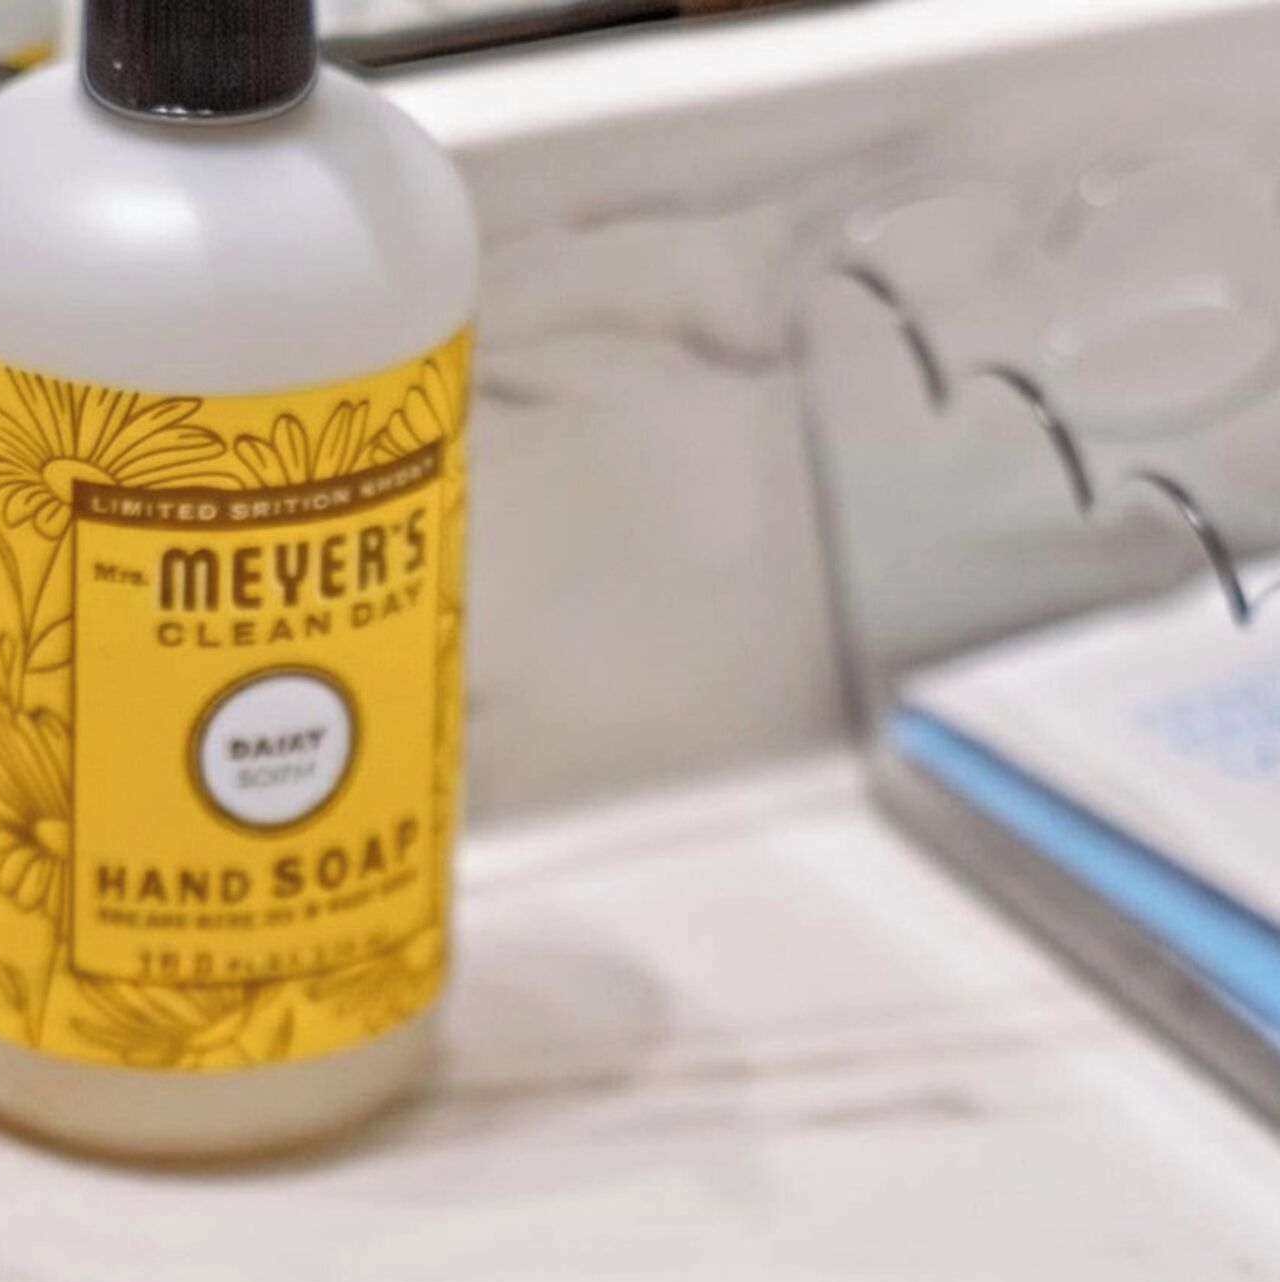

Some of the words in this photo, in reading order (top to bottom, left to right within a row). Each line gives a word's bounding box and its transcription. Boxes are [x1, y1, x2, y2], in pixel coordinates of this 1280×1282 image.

[91, 495, 217, 522] LIMITED
[159, 506, 426, 612] MEYER'S
[156, 610, 332, 648] CLEAN
[350, 581, 423, 629] DAY
[95, 864, 251, 905] HAND
[272, 815, 418, 898] SOAP
